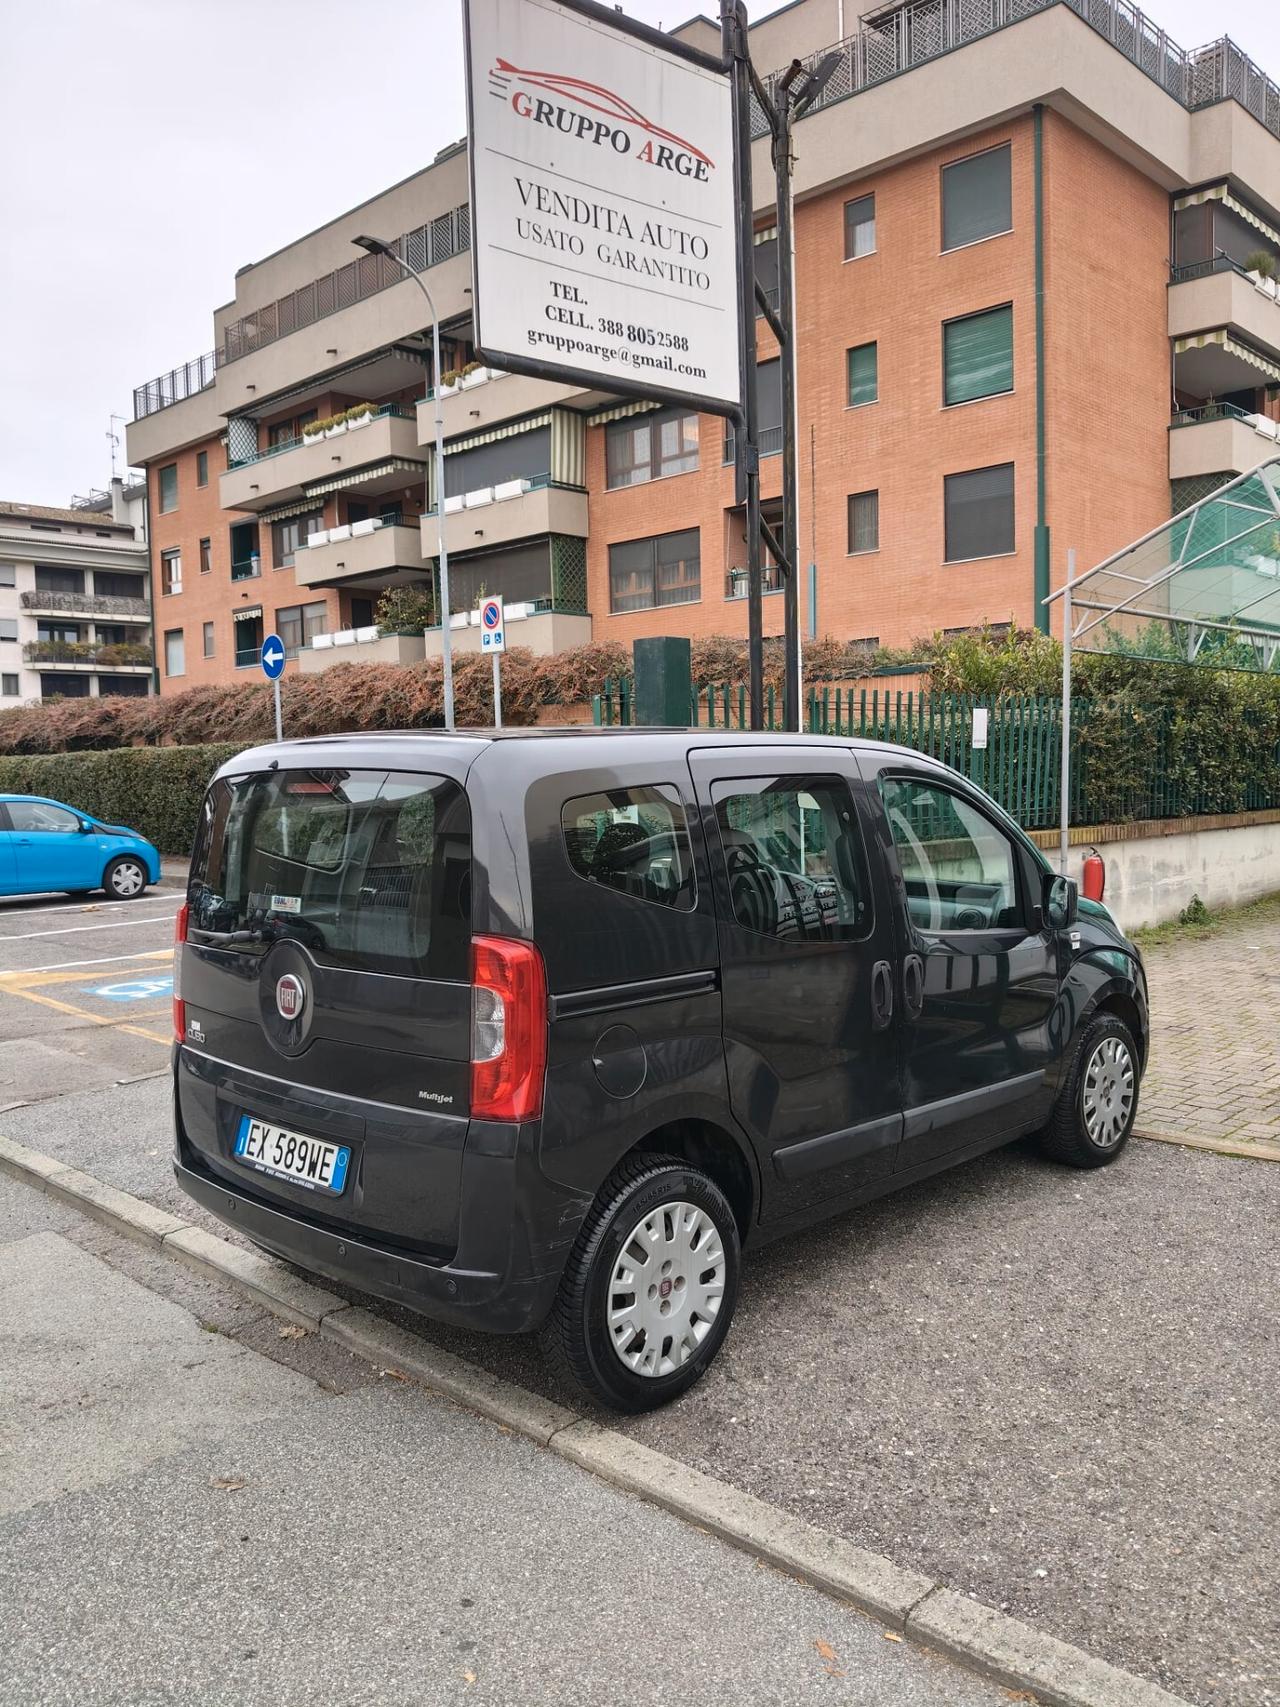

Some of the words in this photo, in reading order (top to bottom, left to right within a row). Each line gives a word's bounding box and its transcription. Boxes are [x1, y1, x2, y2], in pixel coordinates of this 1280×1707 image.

[512, 91, 631, 154] GRUPPO
[636, 140, 709, 183] ARGE
[514, 178, 633, 240] VENDITA
[641, 224, 709, 261] AUTO
[516, 218, 584, 256] USATO
[597, 245, 711, 291] GARANTITO
[549, 281, 588, 306] TEL.
[545, 305, 594, 331] CELL.
[598, 317, 624, 338] 388
[527, 329, 707, 379] gruppoarge@gmail.com
[281, 987, 296, 1009] FIAT
[246, 1124, 271, 1161] EX
[273, 1133, 335, 1183] 589WE
